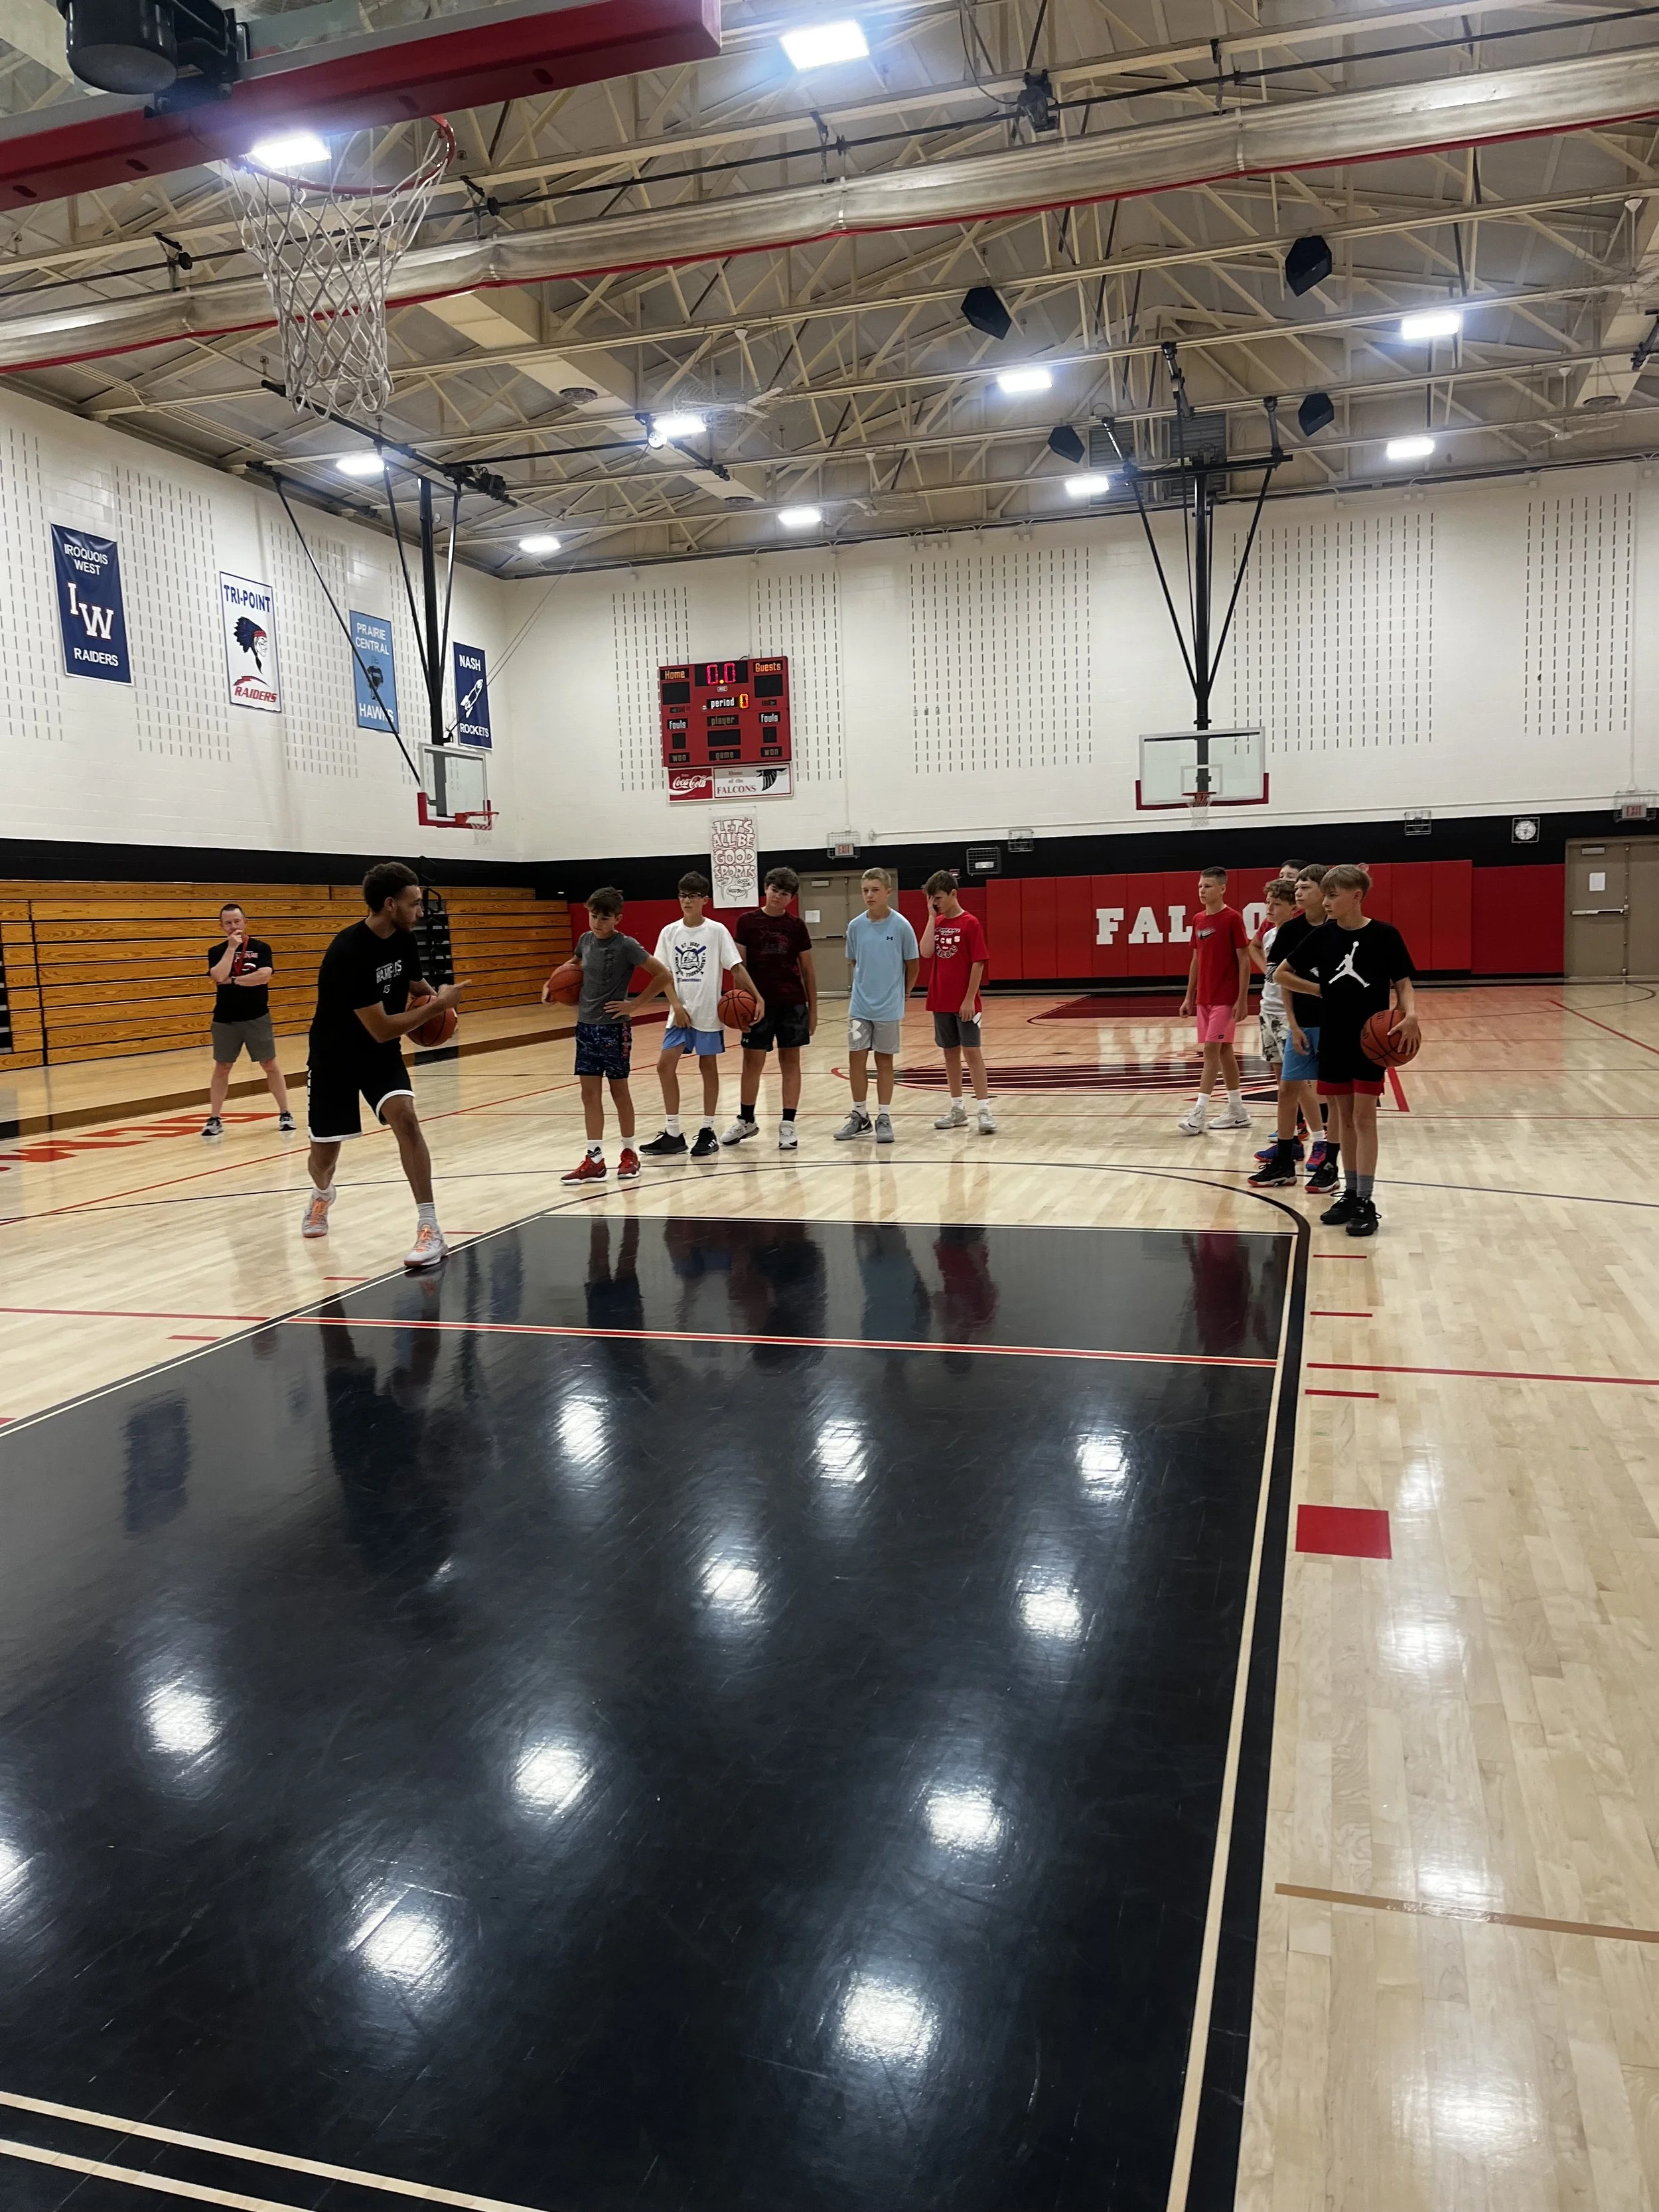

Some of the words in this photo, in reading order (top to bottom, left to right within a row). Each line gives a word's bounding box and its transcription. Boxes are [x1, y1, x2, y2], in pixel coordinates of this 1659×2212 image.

[64, 544, 108, 565] IROQUOIS
[74, 559, 101, 575] WEST
[224, 585, 271, 613] TRI-POINT
[356, 623, 386, 641] PRAIRIE
[355, 637, 390, 655] CENTRAL
[74, 647, 119, 667] RAIDERS
[459, 654, 481, 672] NASH
[664, 670, 685, 680] Home
[755, 662, 781, 672] Guests
[234, 686, 278, 703] RAIDERS
[711, 697, 735, 709] period
[711, 715, 735, 725] player
[460, 722, 490, 738] ROCKETS
[715, 751, 734, 760] game
[717, 785, 757, 794] FALCONS
[713, 817, 754, 834] LET'S
[711, 833, 737, 848] ALL
[737, 833, 755, 848] BE
[713, 847, 756, 865] GOOD
[714, 864, 756, 879] SPORTS
[1096, 902, 1267, 945] FALO
